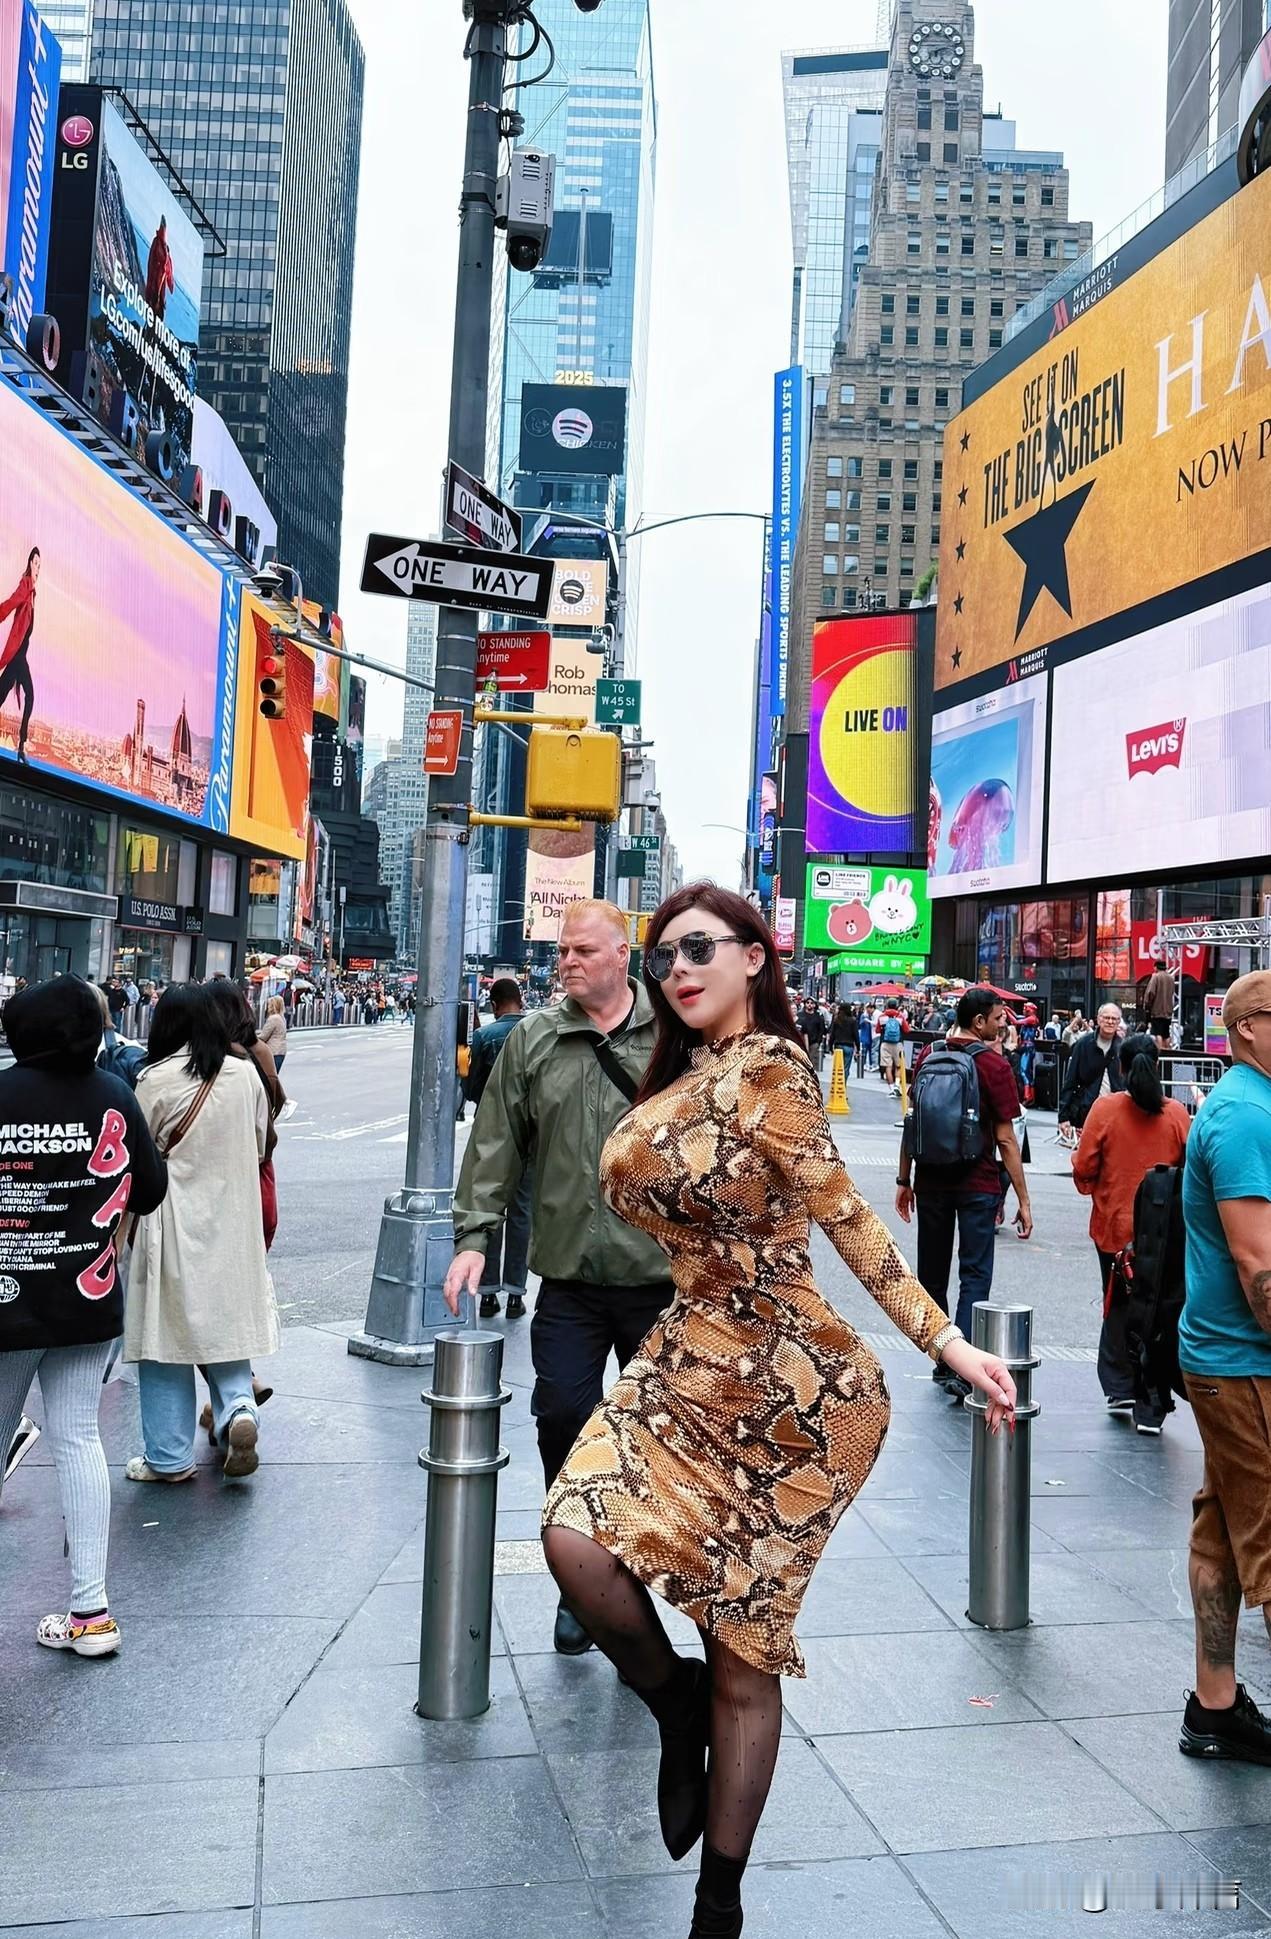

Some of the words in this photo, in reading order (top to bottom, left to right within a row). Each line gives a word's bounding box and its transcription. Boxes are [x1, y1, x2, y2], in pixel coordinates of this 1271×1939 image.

[61, 152, 89, 170] LG
[1073, 255, 1119, 301] MARRIOTT
[1072, 277, 1112, 317] MARQUIS
[113, 258, 154, 328] Explore
[155, 316, 180, 358] more
[554, 369, 594, 386] 2025
[782, 378, 792, 409] 3.5X
[1022, 373, 1043, 434] SEE
[1061, 346, 1079, 405] ON
[781, 411, 792, 433] THE
[984, 448, 1011, 529] THE
[1014, 427, 1042, 510] BIG
[1056, 367, 1125, 483] SCREEN
[1175, 430, 1248, 504] NOW
[460, 490, 482, 526] ONE
[490, 513, 512, 547] WAY
[780, 539, 790, 561] THE
[393, 556, 446, 585] ONE
[471, 567, 528, 597] WAY
[779, 563, 790, 613] LEADING
[552, 604, 592, 616] CRISP
[489, 637, 531, 650] STANDING
[477, 652, 510, 666] nytime
[554, 664, 585, 680] Rob
[548, 679, 596, 696] homas
[612, 683, 625, 693] TO
[601, 696, 610, 705] W
[610, 696, 624, 706] 45
[844, 708, 878, 733] LIVE
[882, 705, 908, 732] ON
[640, 837, 650, 848] 46
[143, 903, 159, 919] POLO
[843, 957, 885, 968] SQUARE
[890, 959, 903, 968] BY
[0, 1137, 92, 1155] ACKSON
[12, 1161, 34, 1170] ONE
[13, 1182, 31, 1190] WAY
[53, 1230, 66, 1239] ME
[33, 1247, 53, 1256] STOP
[53, 1244, 82, 1254] LOVING
[82, 1241, 99, 1251] YOU
[18, 1261, 56, 1271] CRIMINAL
